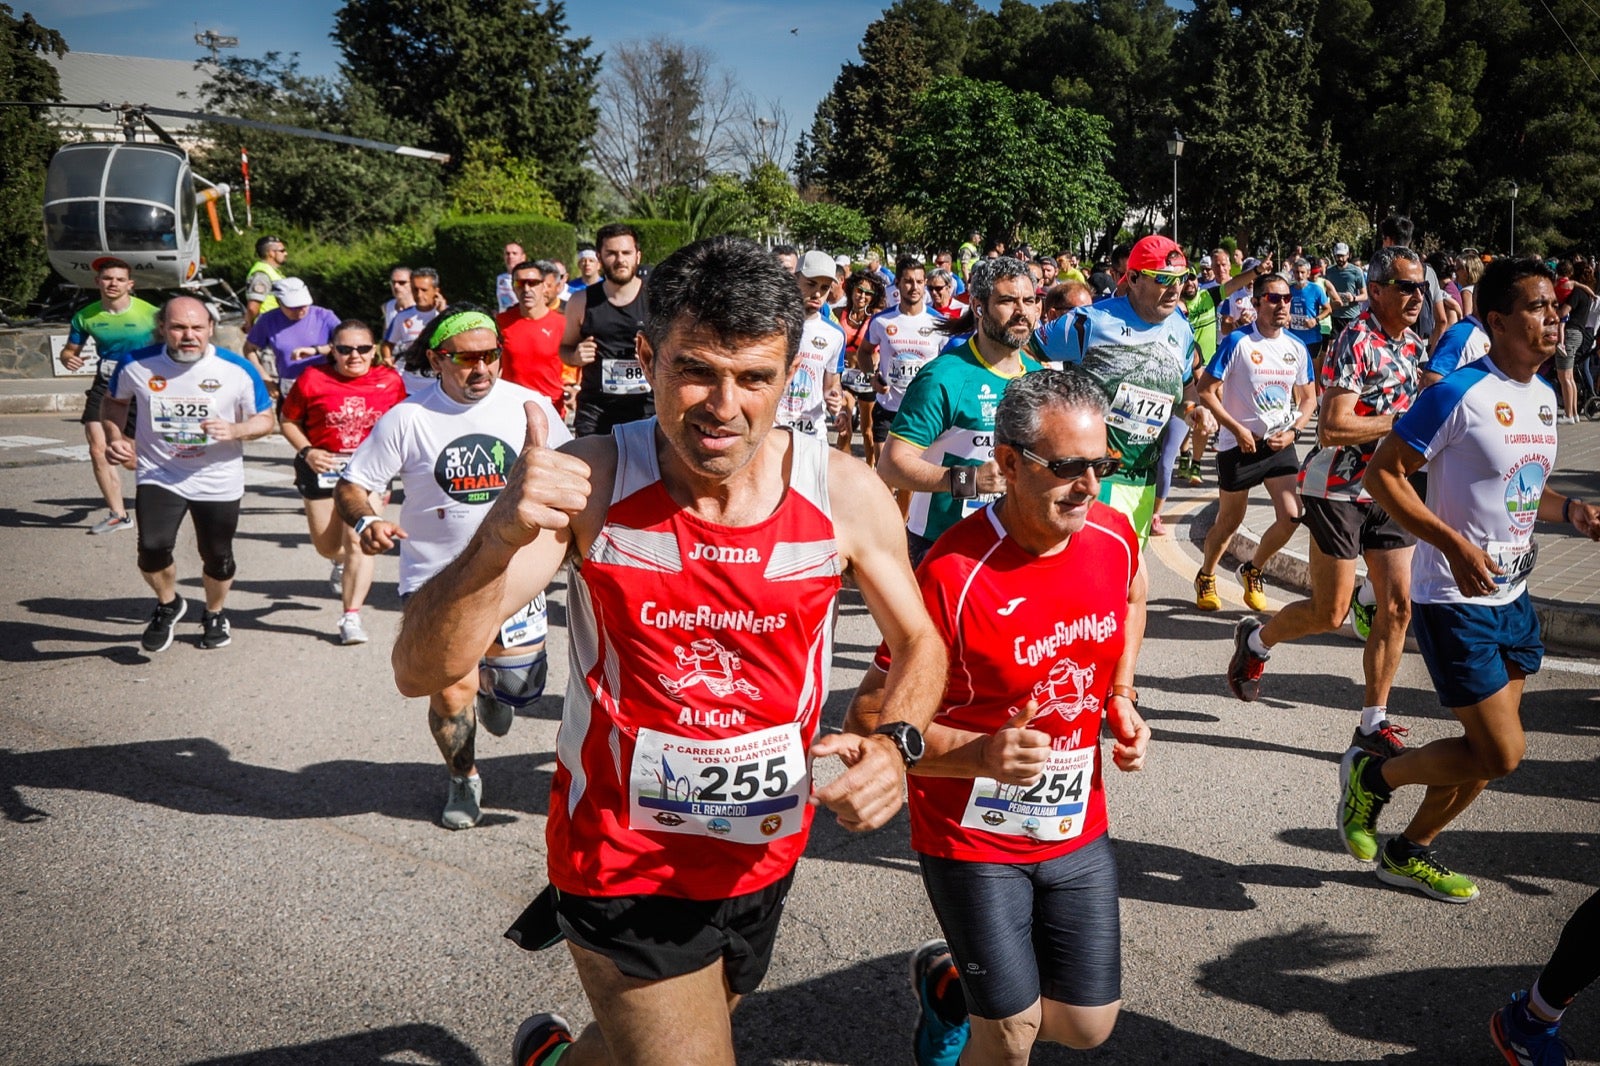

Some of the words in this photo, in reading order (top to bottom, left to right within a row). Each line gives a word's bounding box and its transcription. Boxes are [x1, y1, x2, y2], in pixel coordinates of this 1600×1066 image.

[174, 403, 209, 418] 325
[1137, 399, 1165, 420] 174
[1509, 434, 1531, 444] CARRERA
[445, 462, 497, 480] DOLAR
[451, 474, 506, 490] TRAIL
[468, 492, 489, 501] 2021
[677, 746, 731, 755] CARRERA
[734, 741, 759, 753] BASE
[698, 756, 788, 802] 255
[1020, 770, 1083, 804] 254
[691, 803, 702, 814] EL
[703, 804, 747, 816] RENACIDO
